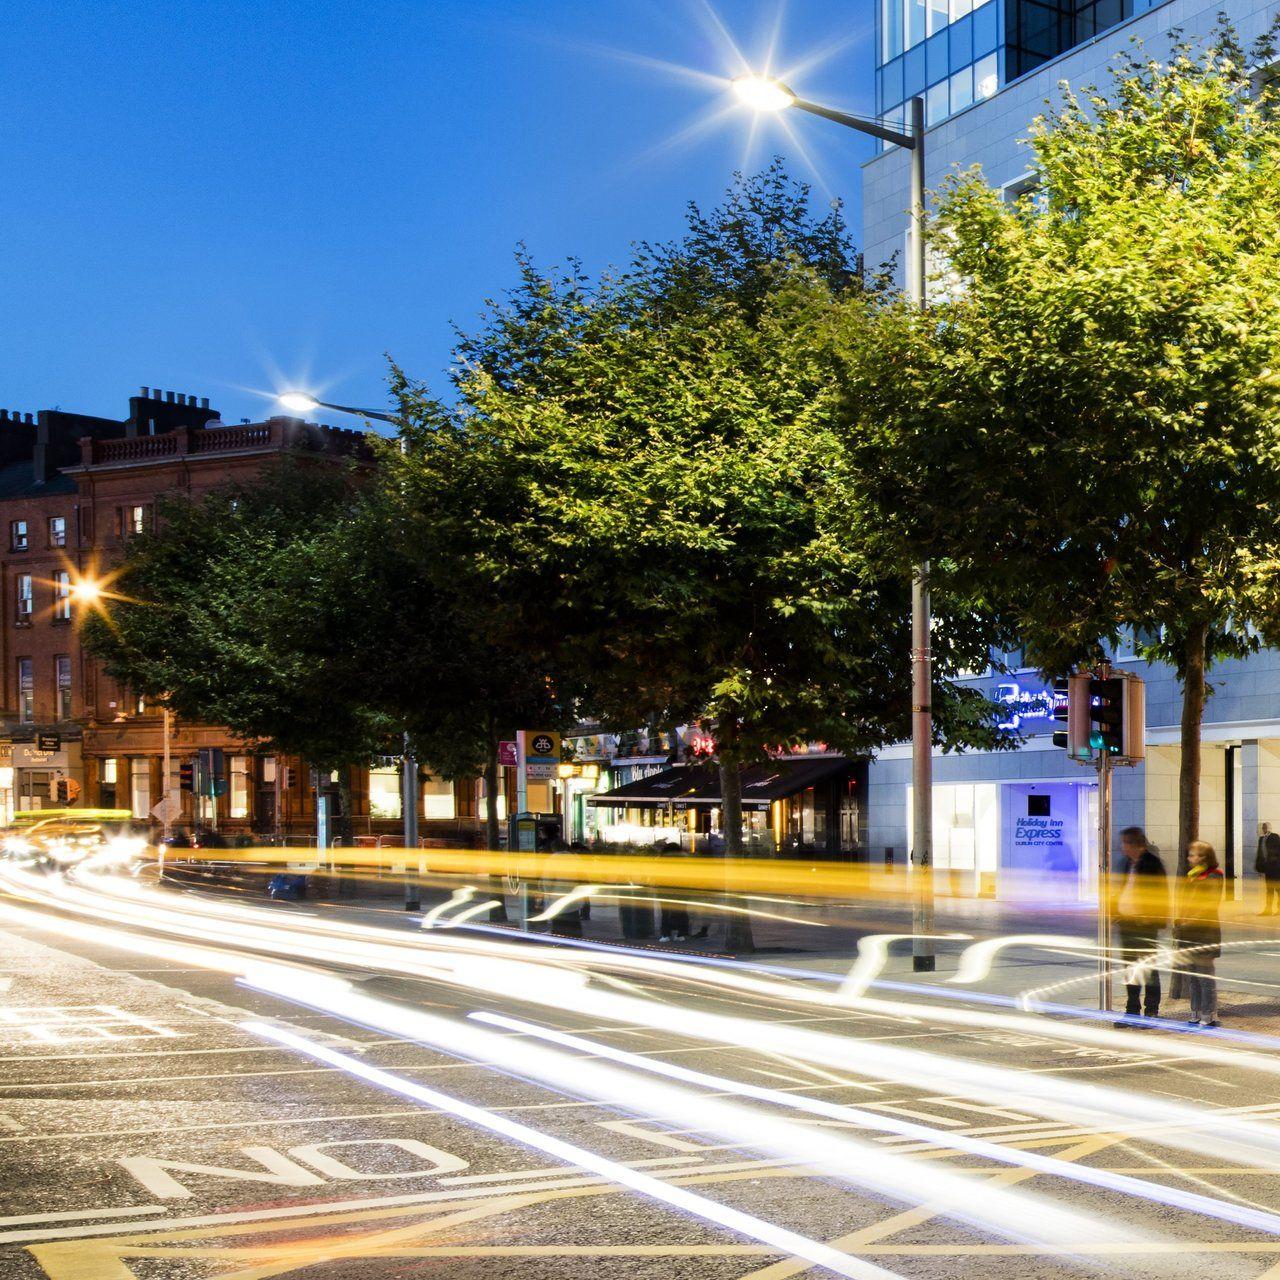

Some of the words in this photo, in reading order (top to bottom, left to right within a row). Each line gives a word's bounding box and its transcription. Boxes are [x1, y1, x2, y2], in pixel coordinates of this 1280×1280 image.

[1016, 818, 1047, 828] Holiday
[1015, 827, 1061, 841] Express
[118, 1138, 470, 1199] NO
